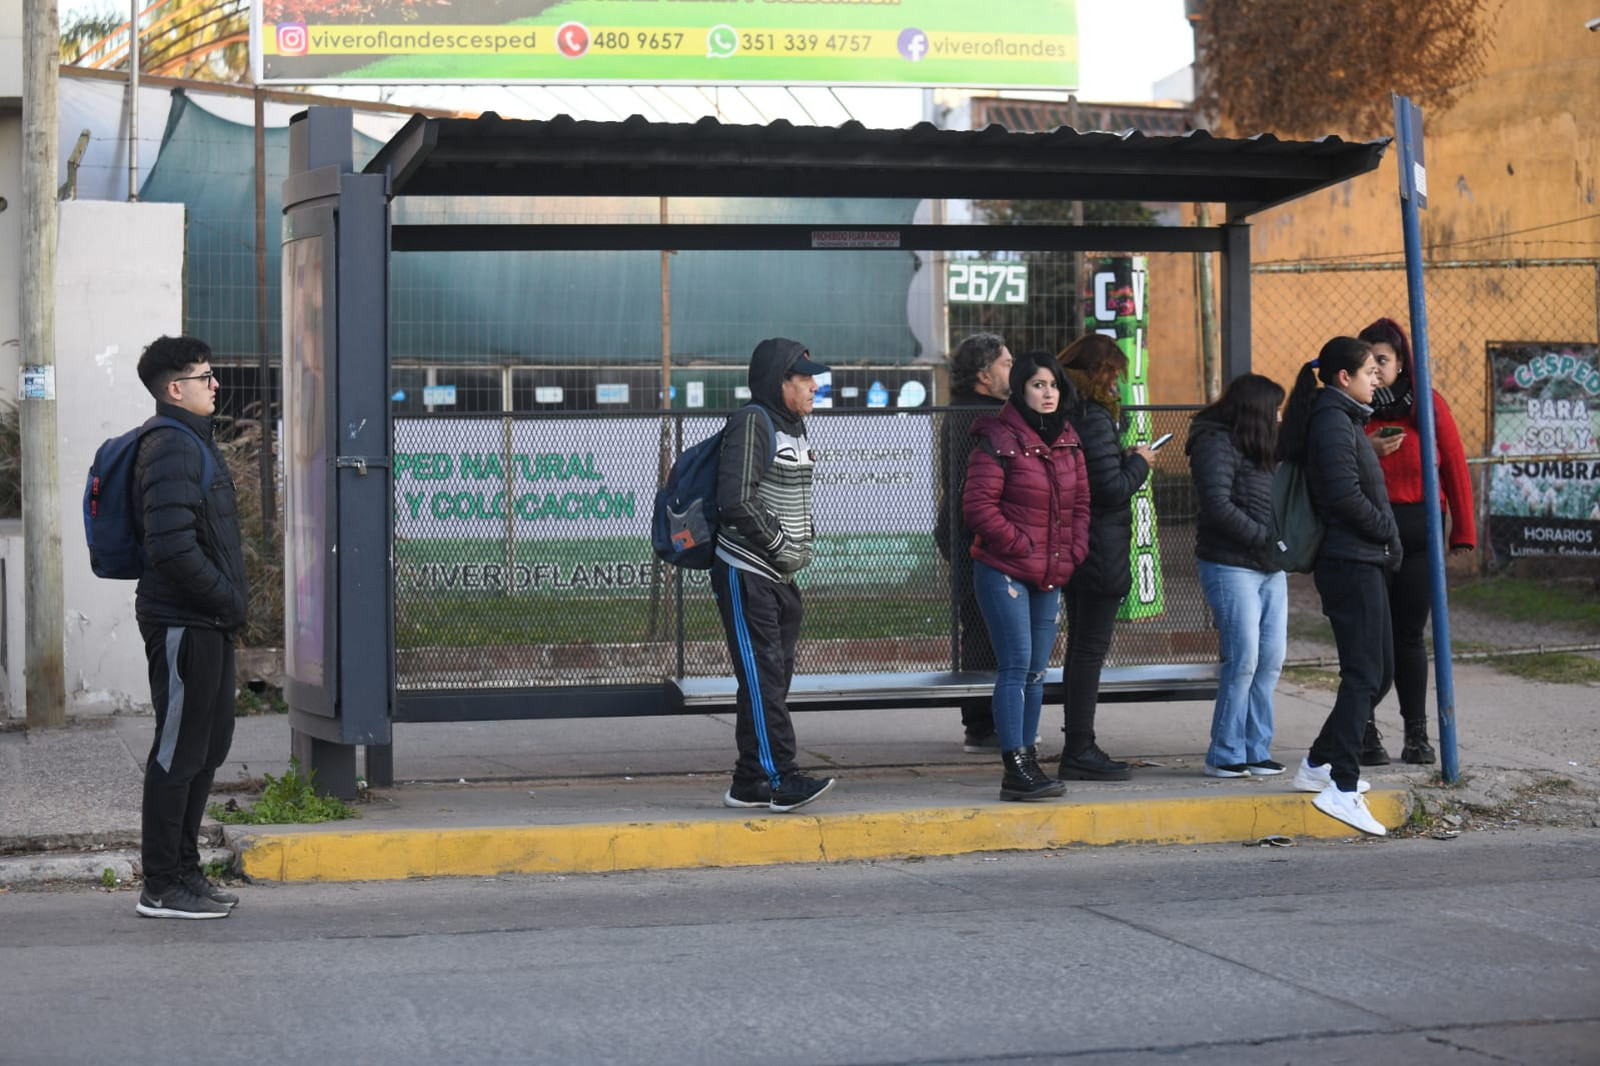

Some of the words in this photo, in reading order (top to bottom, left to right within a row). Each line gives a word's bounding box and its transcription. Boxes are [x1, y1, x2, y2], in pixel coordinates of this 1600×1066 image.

[312, 31, 536, 52] viveroflandescesped
[593, 31, 630, 49] 480
[637, 32, 684, 49] 9657
[742, 34, 774, 51] 351
[784, 34, 817, 51] 339
[826, 35, 872, 52] 4757
[934, 37, 1066, 57] viveroflandes
[949, 264, 1027, 302] 2675
[1514, 353, 1600, 395] CESPED
[1527, 399, 1589, 421] PARA
[1131, 271, 1156, 603] VIVRO
[1525, 427, 1567, 449] SOL
[1574, 427, 1591, 449] Y
[404, 491, 424, 519] Y
[1524, 527, 1593, 543] HORARIOS
